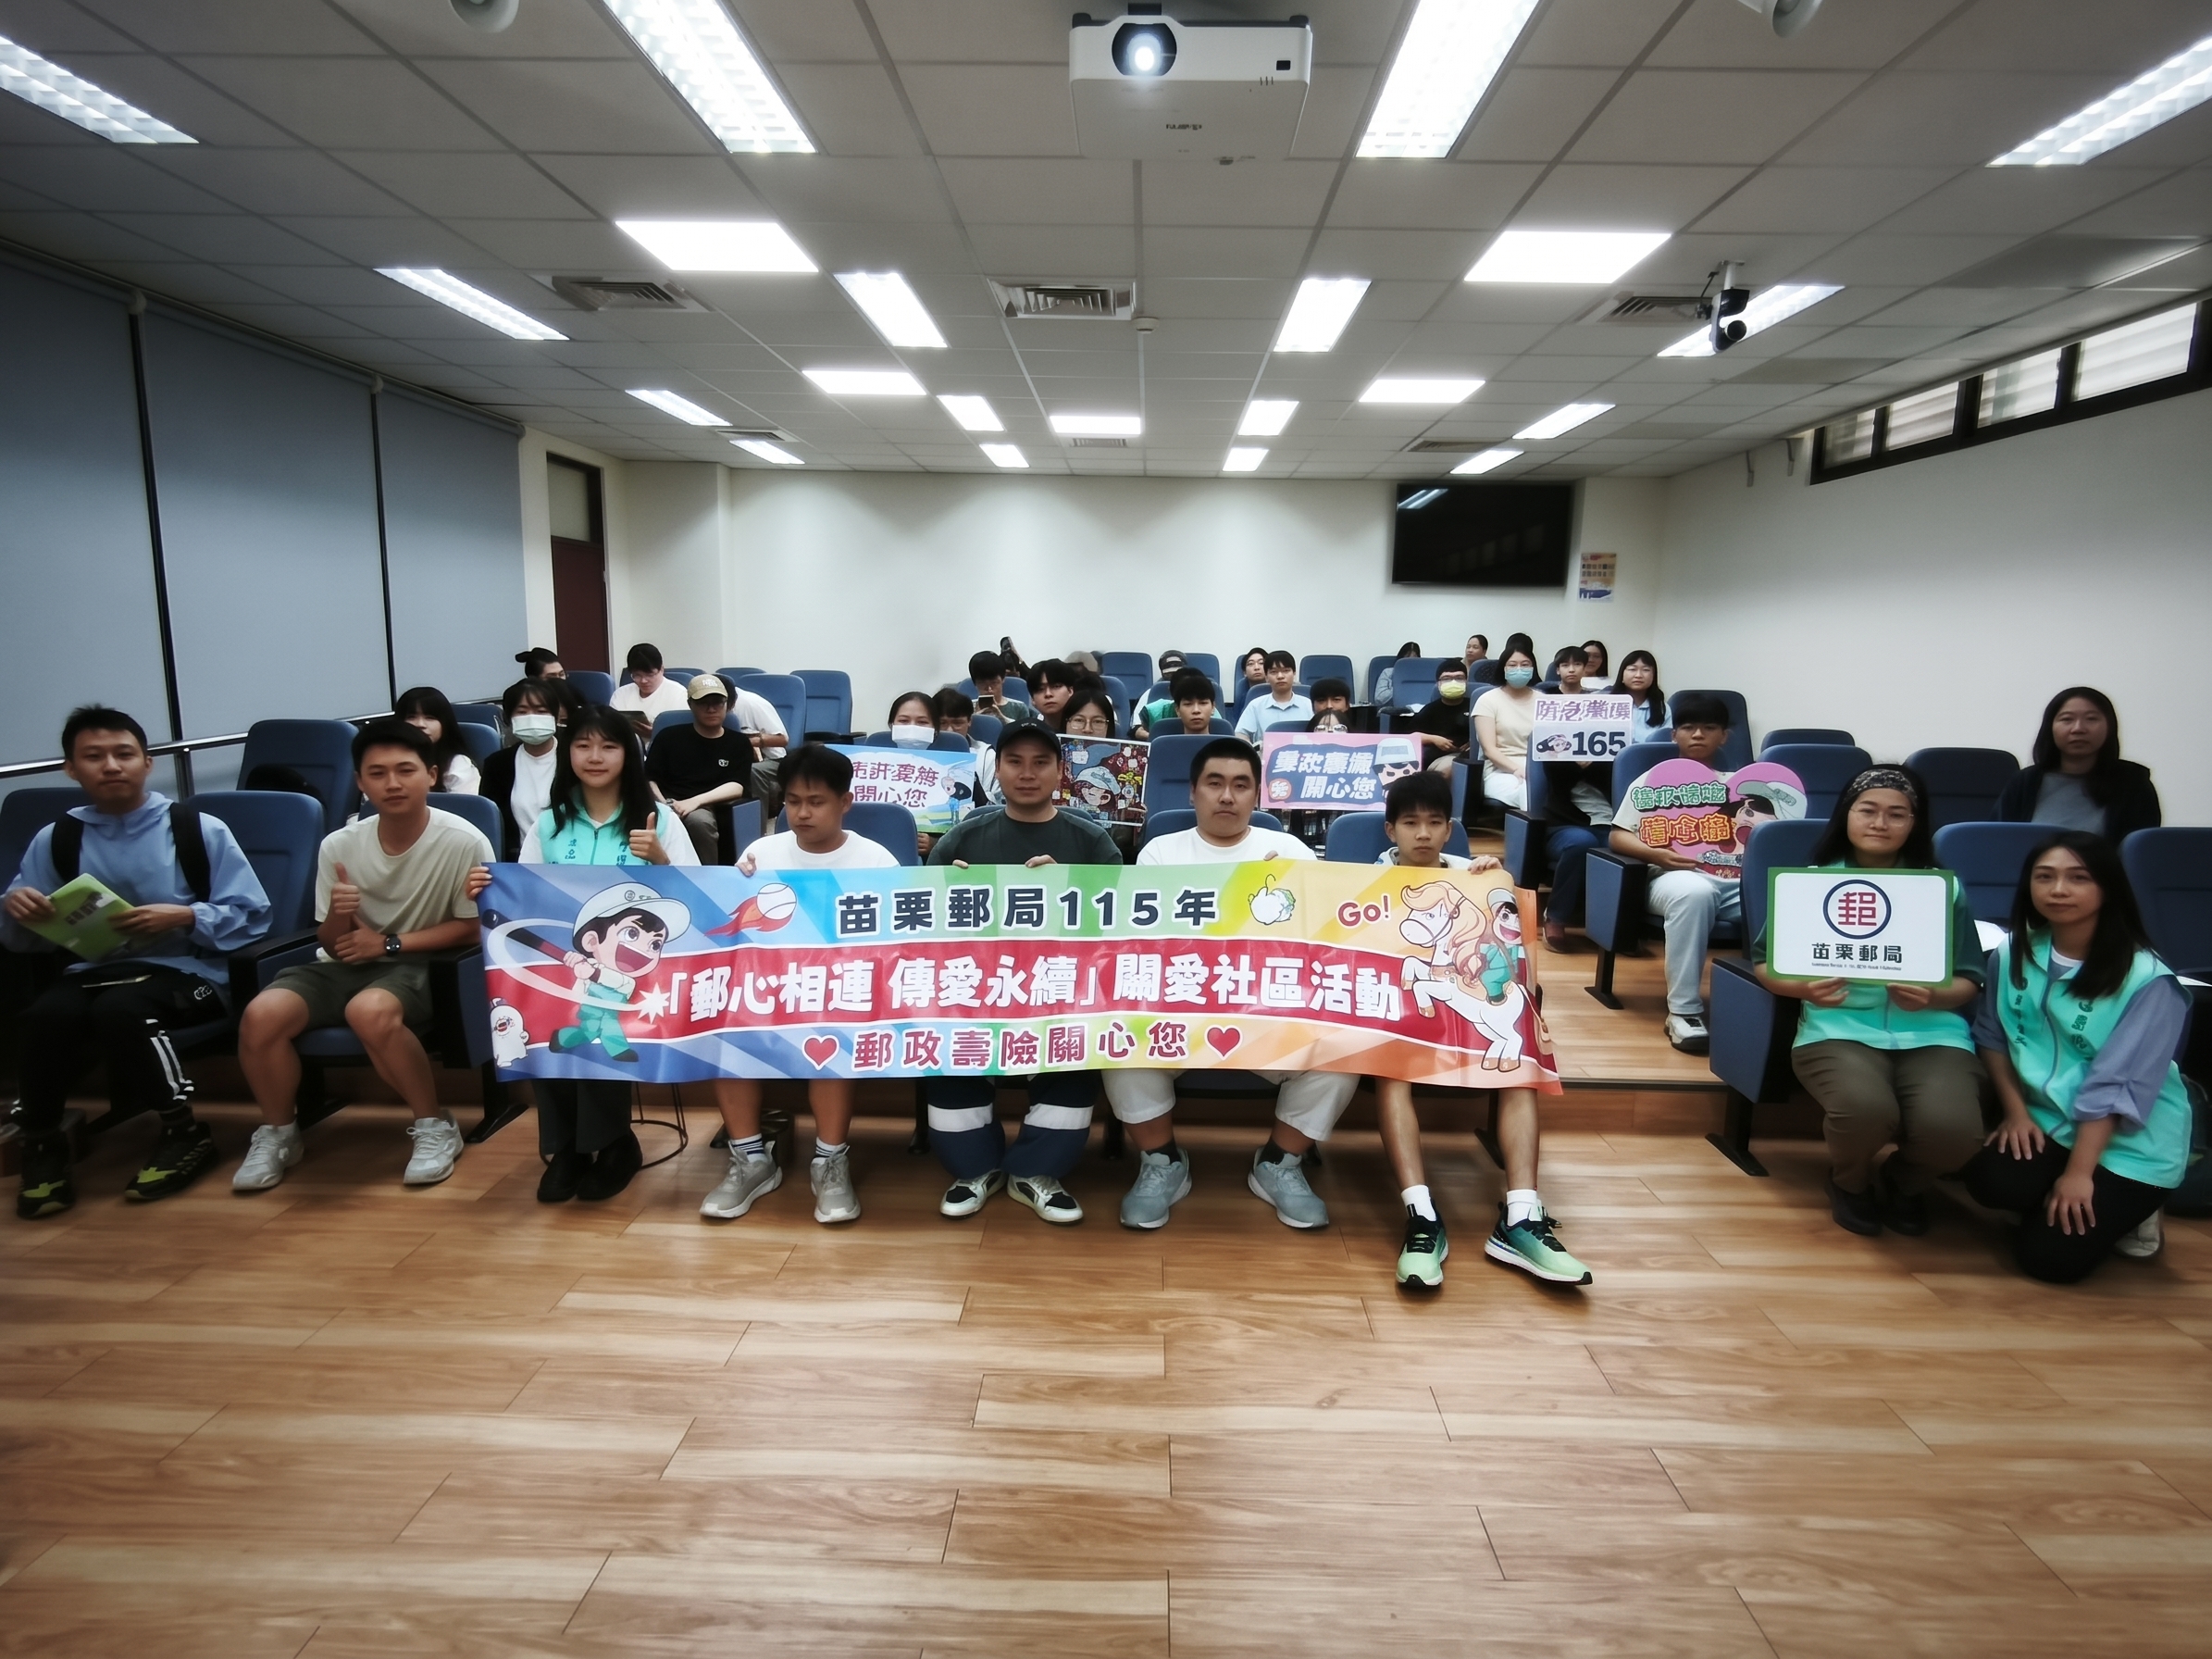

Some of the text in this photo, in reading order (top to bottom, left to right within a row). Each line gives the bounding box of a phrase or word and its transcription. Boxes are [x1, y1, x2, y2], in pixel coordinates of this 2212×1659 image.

[1572, 731, 1627, 756] 165
[838, 888, 1216, 935] 苗栗郵局115年
[1337, 894, 1390, 927] Go!
[1838, 892, 1877, 926] 郵
[1811, 942, 1902, 964] 苗栗郵局
[1112, 953, 1401, 1022] 關愛社區活動
[853, 1021, 1187, 1068] 郵政壽險關心您
